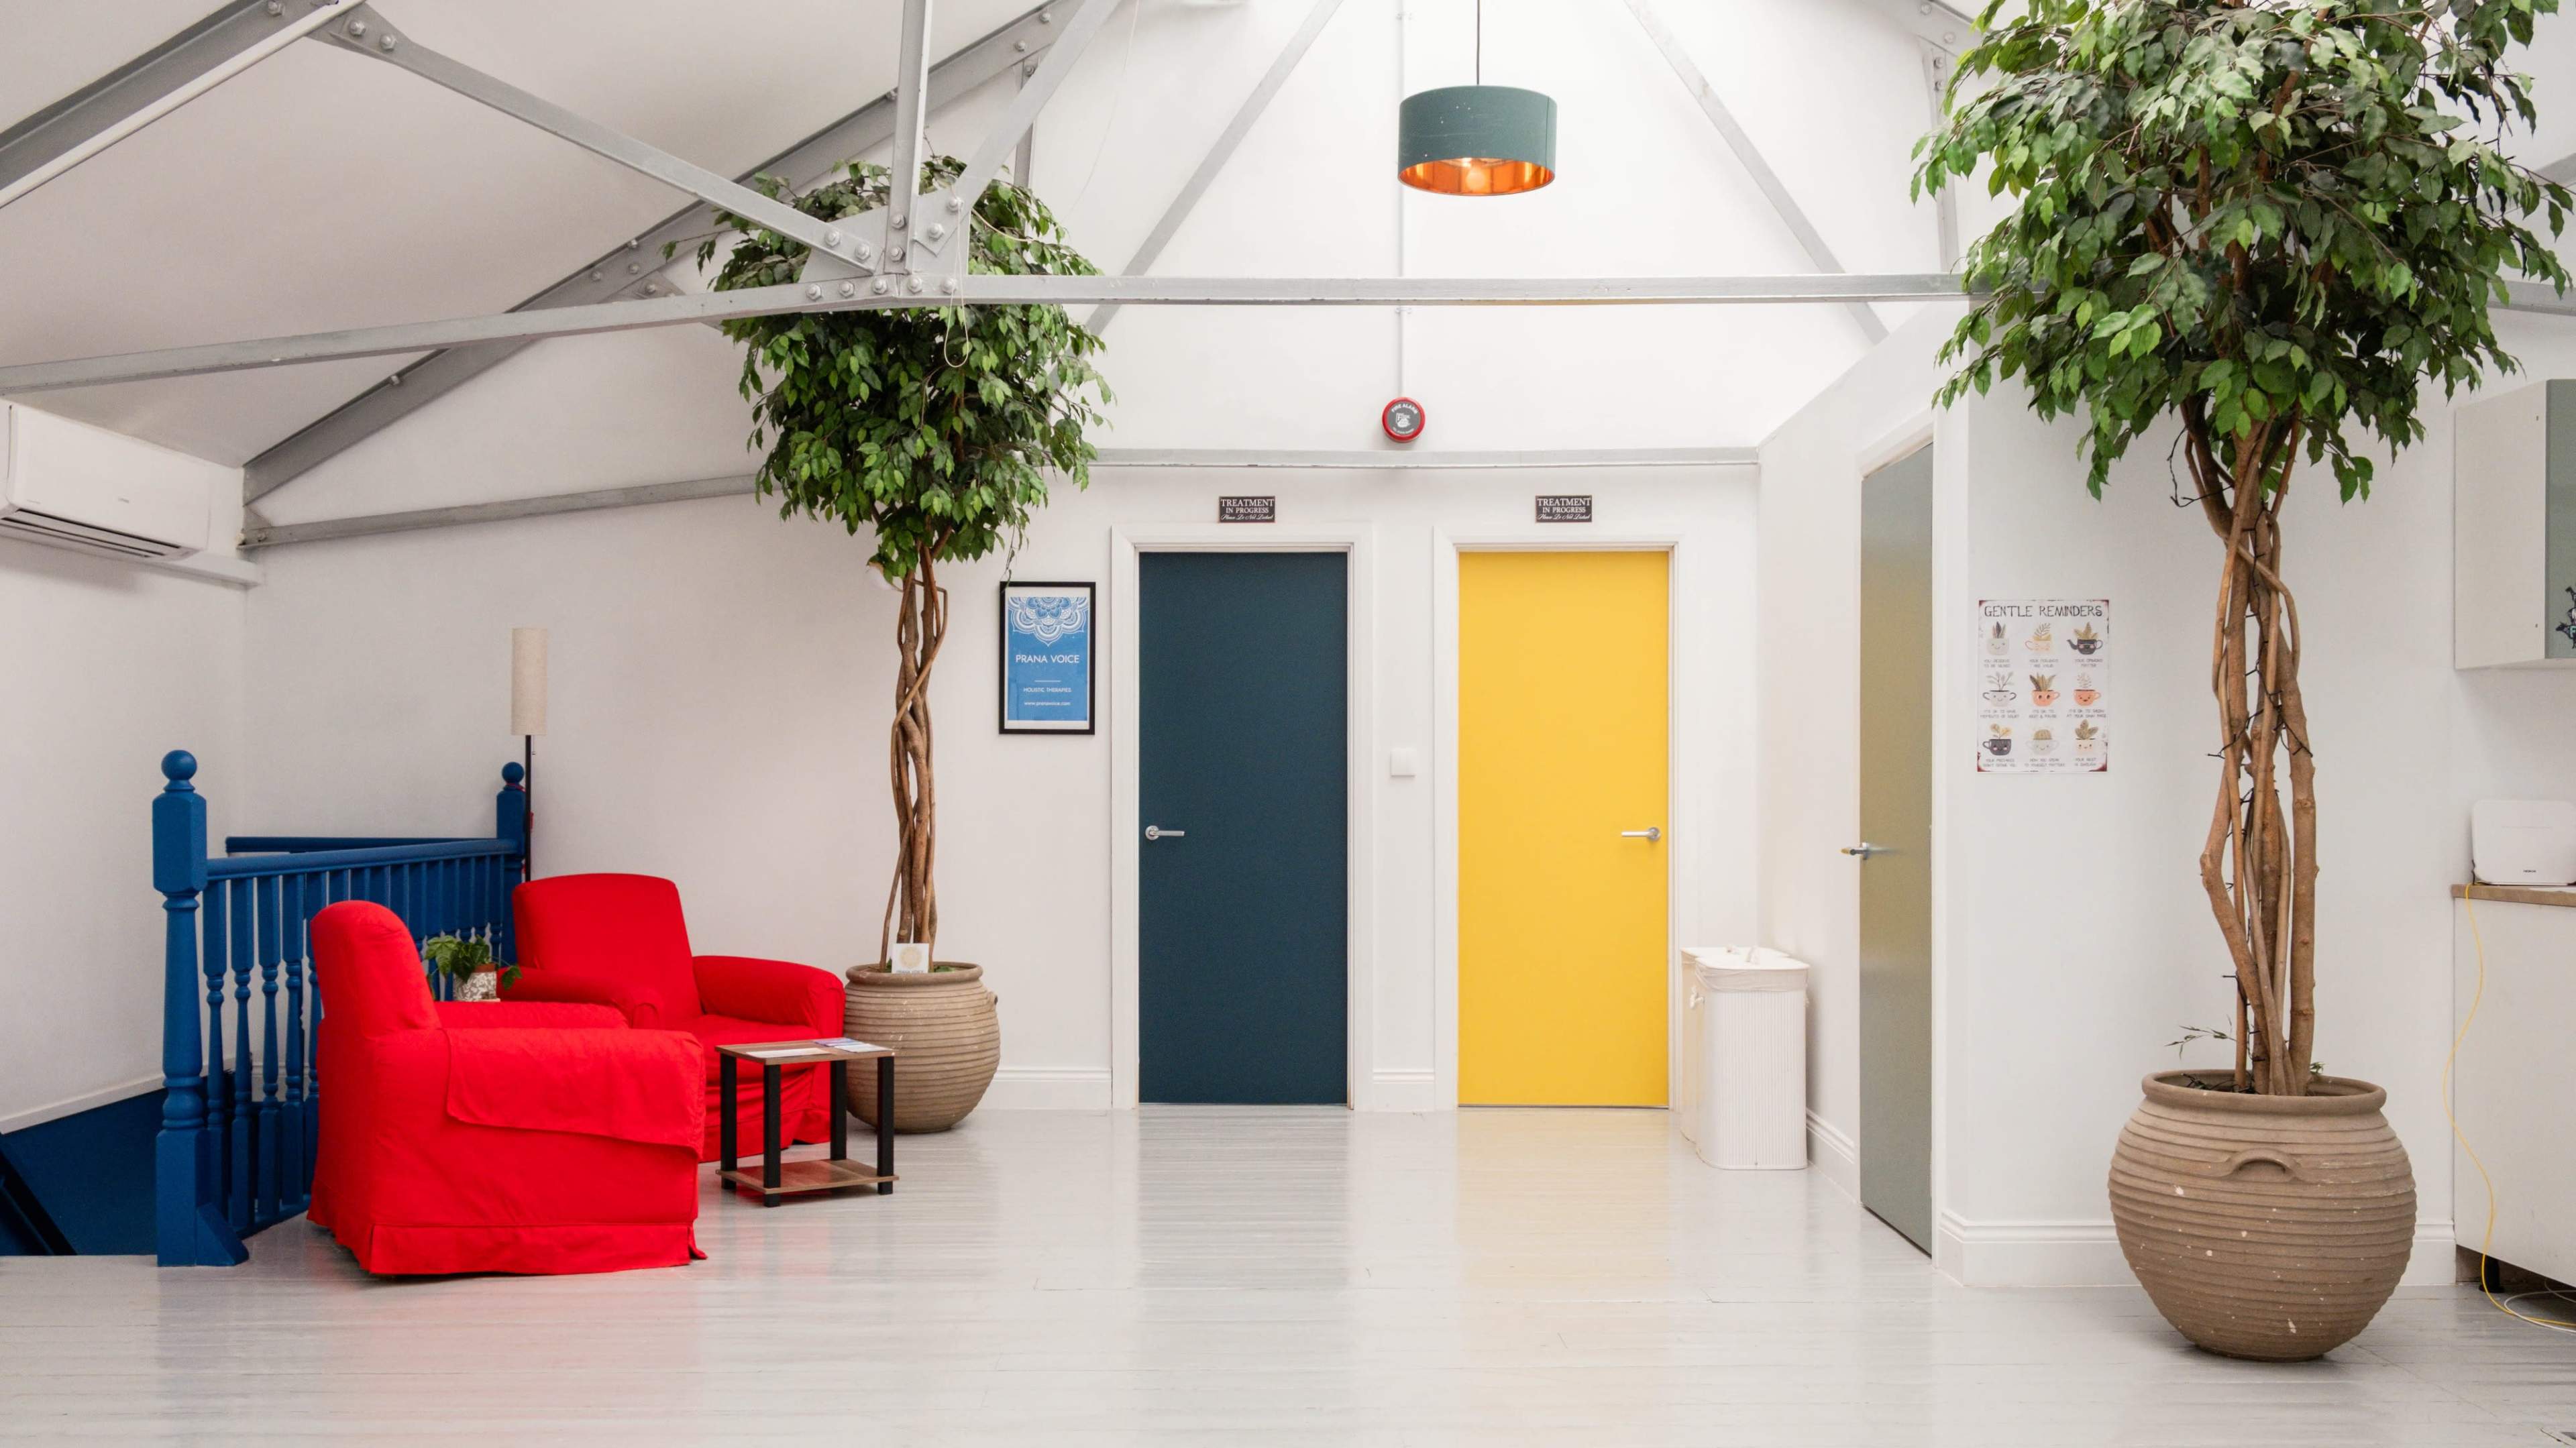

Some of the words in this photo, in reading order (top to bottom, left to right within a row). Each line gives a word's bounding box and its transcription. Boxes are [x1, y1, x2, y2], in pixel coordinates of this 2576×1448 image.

[1221, 498, 1275, 507] TREATMENT
[1537, 498, 1591, 506] TREATMENT
[1984, 606, 2033, 617] GENTLE
[2039, 605, 2103, 617] REMINDERS
[1015, 655, 1048, 663] PRANA
[1050, 655, 1080, 663] VOICE
